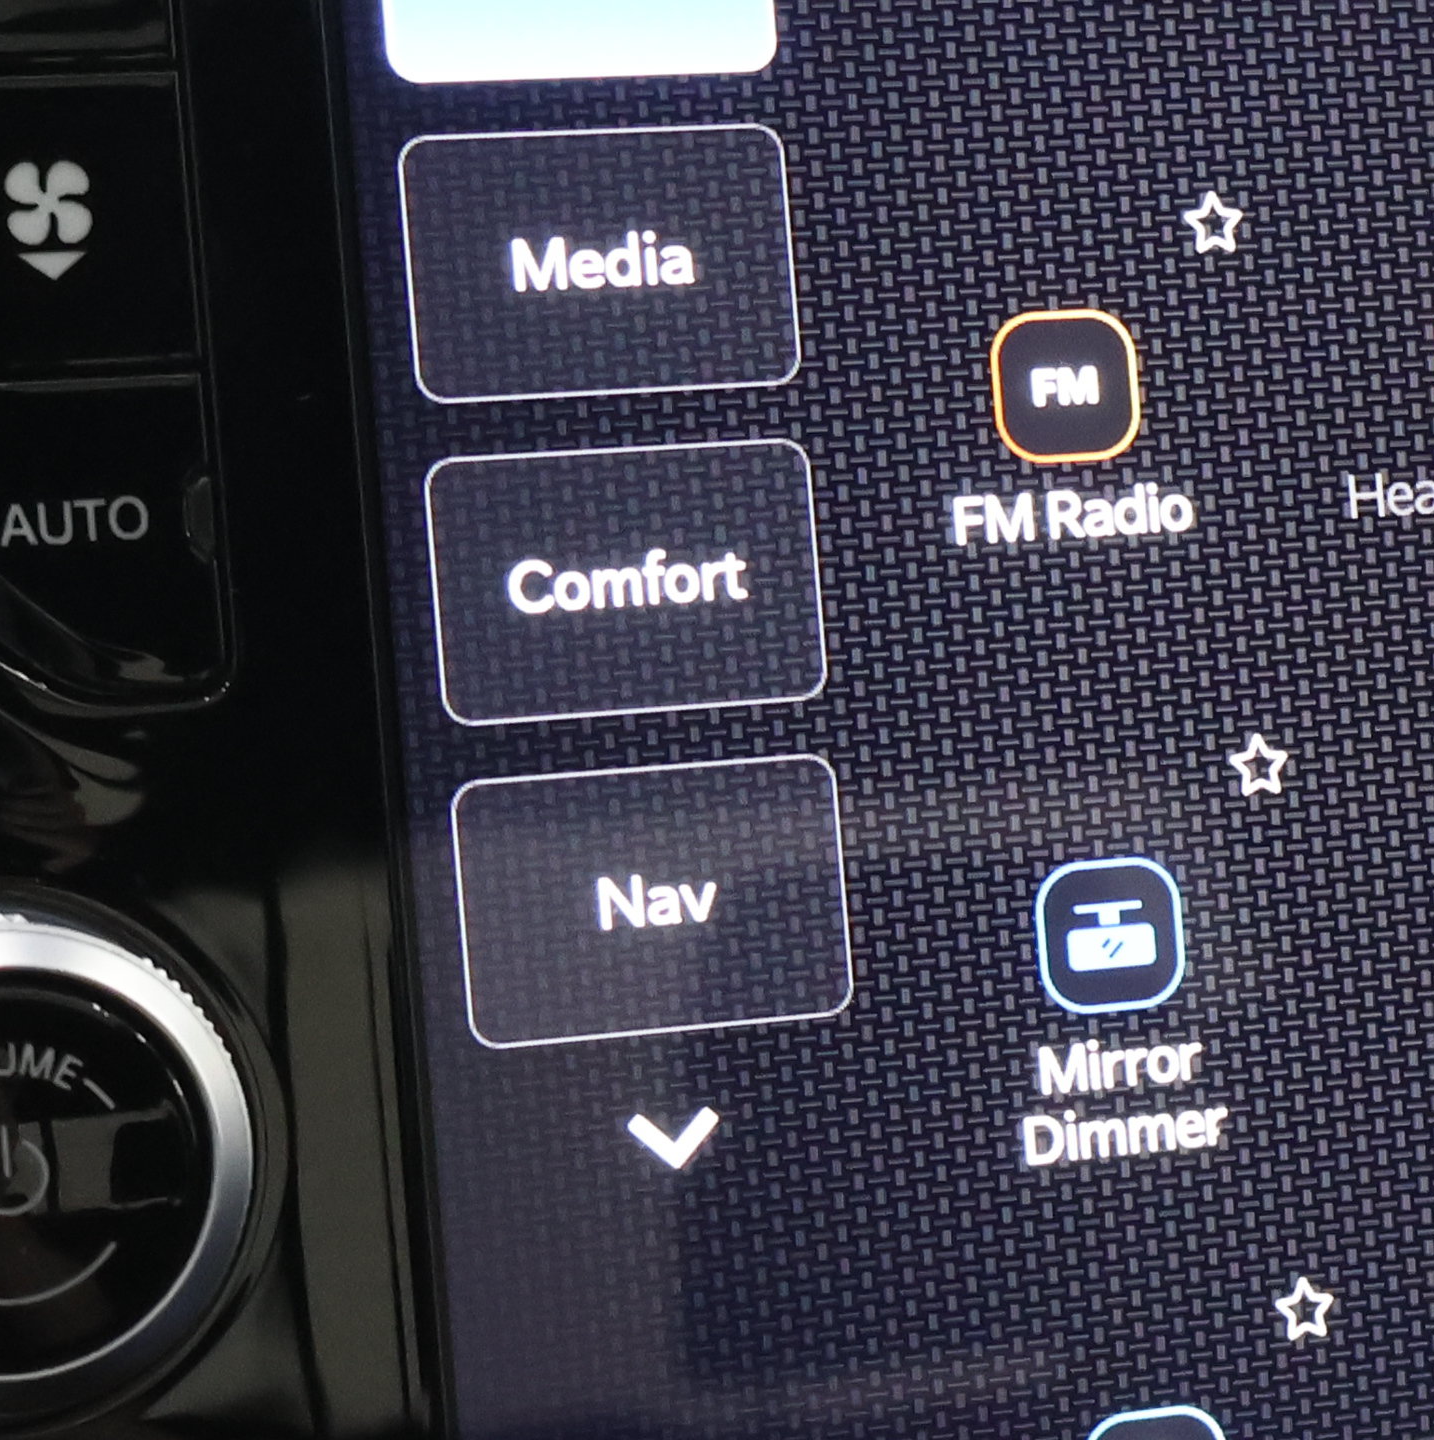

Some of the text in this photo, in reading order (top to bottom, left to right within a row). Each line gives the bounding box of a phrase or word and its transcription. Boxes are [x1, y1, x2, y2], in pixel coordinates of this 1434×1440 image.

[511, 231, 695, 292] Media
[1031, 368, 1100, 407] FM
[0, 497, 148, 547] AUTO
[953, 483, 1193, 545] FM Radio
[507, 550, 748, 614] Comfort
[596, 873, 718, 930] Nav
[1038, 1039, 1202, 1098] Mirror
[1022, 1105, 1228, 1167] Dimmer
